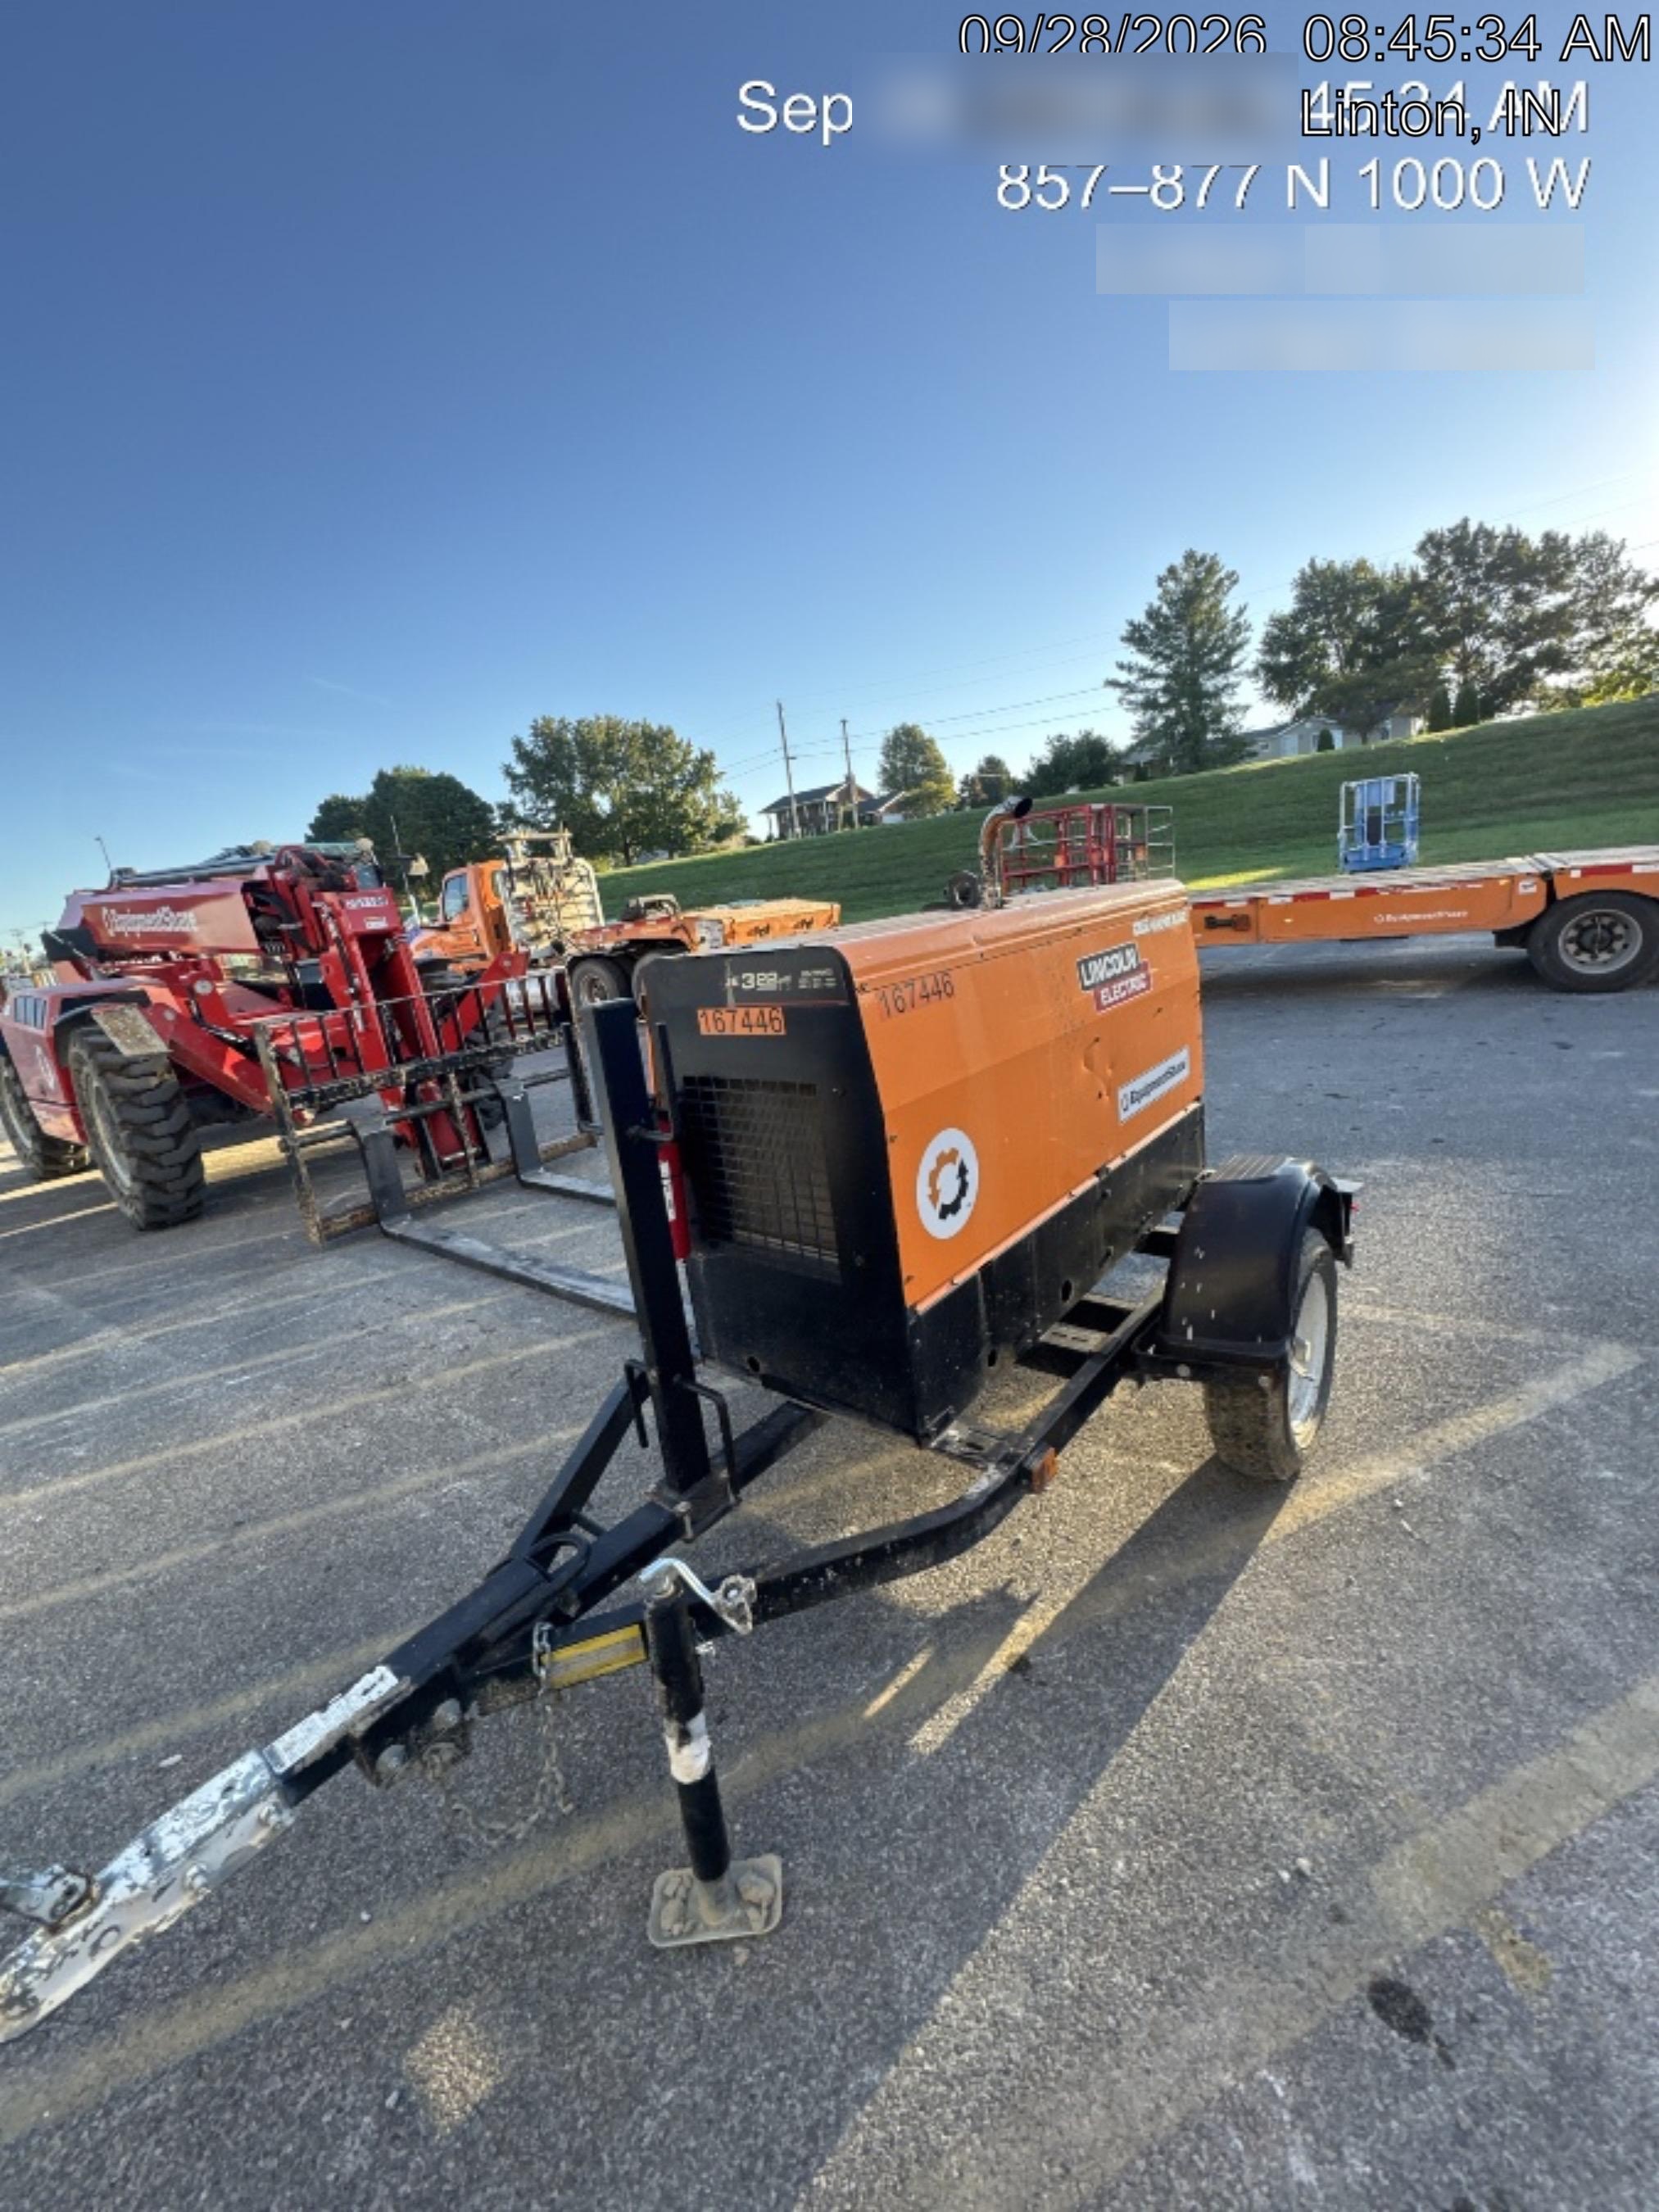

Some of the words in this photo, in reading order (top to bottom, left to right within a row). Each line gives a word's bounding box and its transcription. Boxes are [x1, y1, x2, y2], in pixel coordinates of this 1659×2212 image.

[1080, 945, 1139, 988] LINCOLN
[879, 972, 954, 1018] 167446
[1100, 972, 1148, 1007] ELECTRIC
[699, 1008, 783, 1033] 167446
